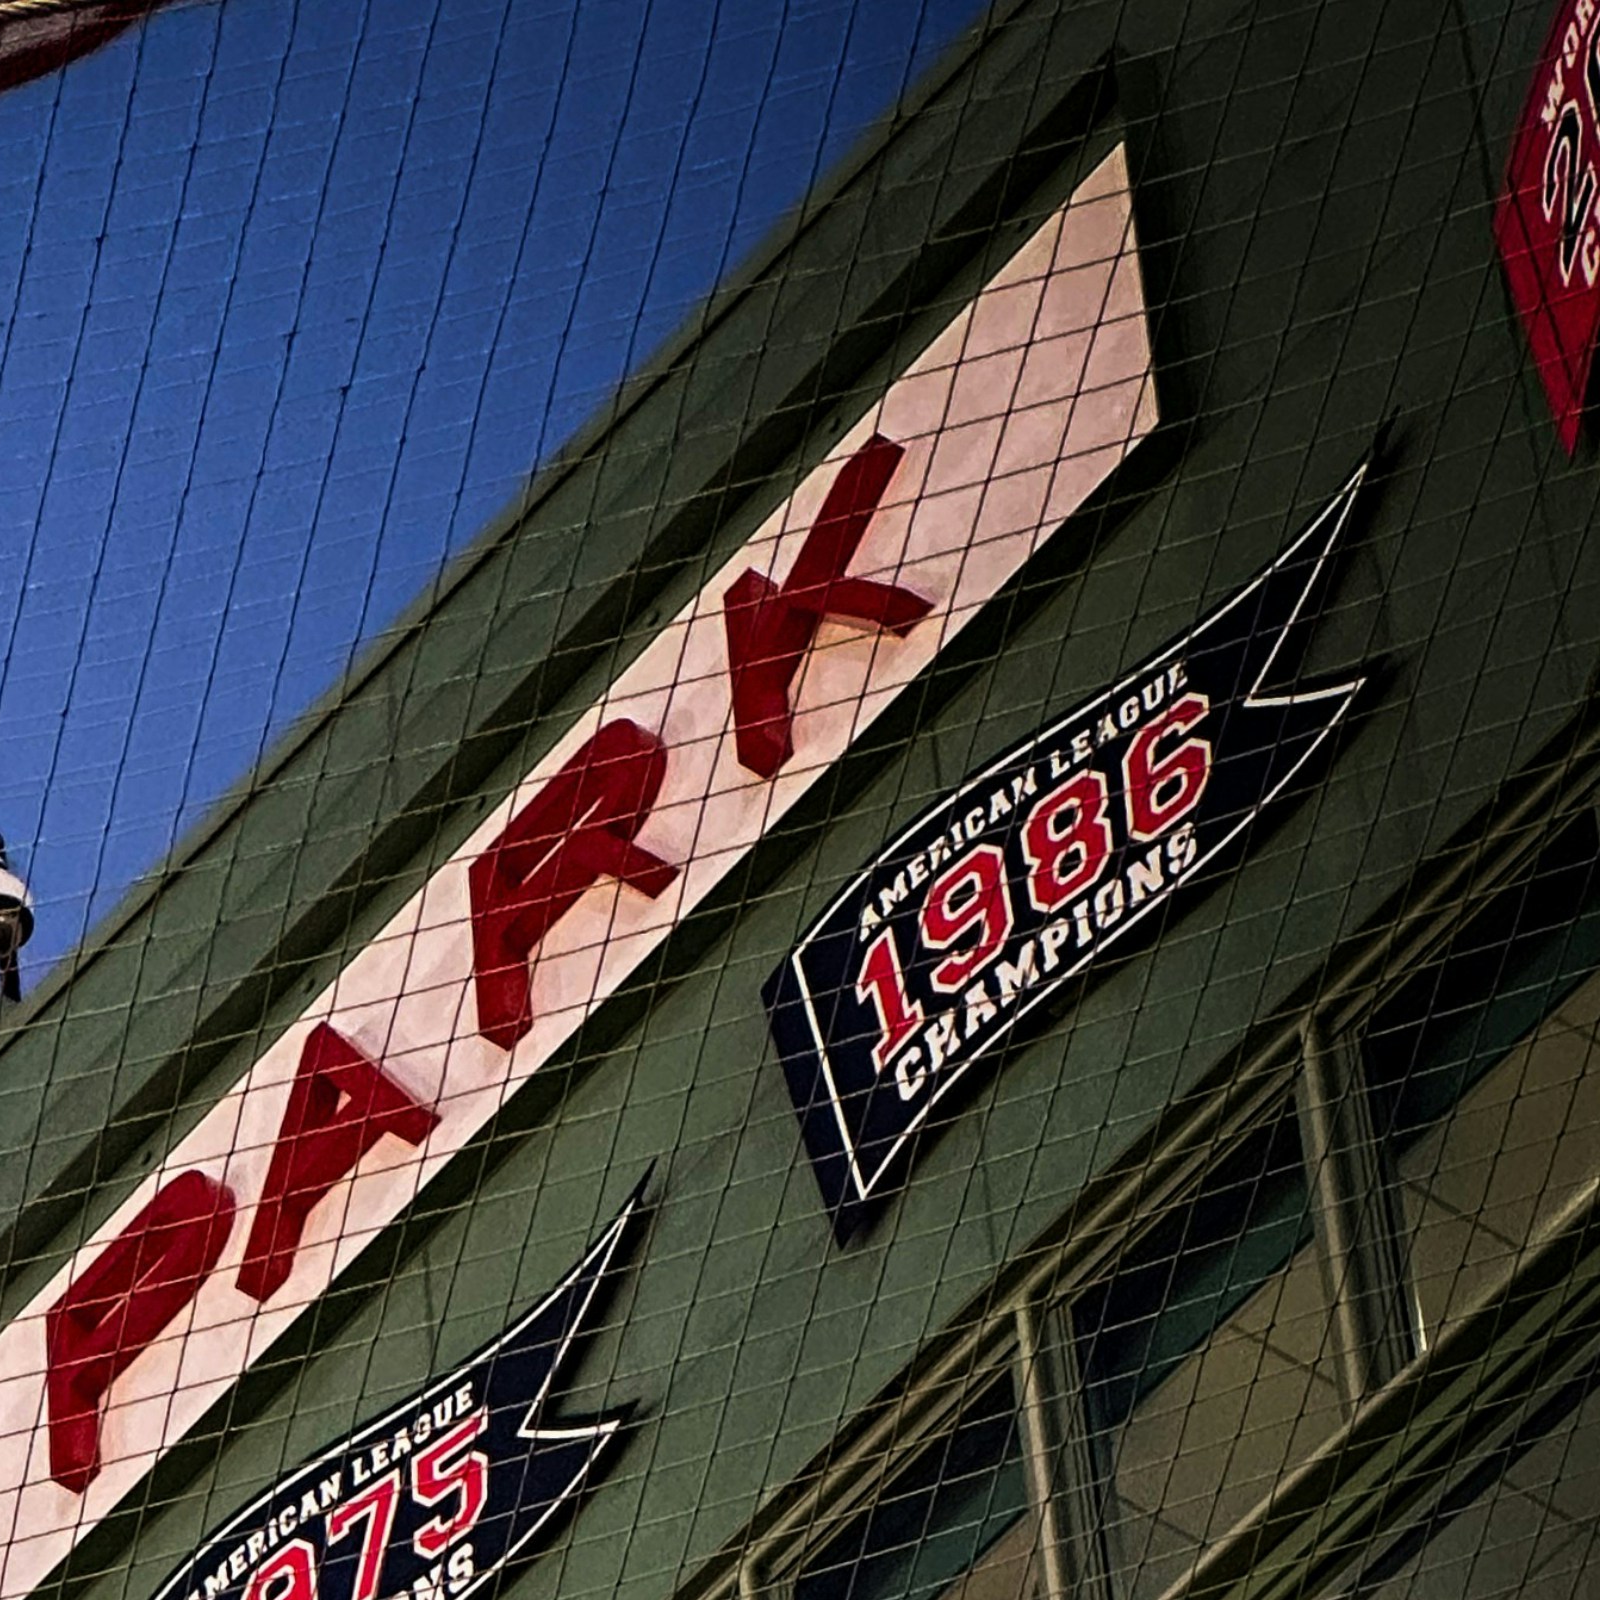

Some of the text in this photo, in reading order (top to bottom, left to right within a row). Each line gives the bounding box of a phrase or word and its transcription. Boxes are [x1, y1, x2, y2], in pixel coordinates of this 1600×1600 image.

[856, 691, 1212, 1074] 1986
[858, 661, 1188, 941] AMERICAN LEAGUE
[45, 434, 936, 1495] PARK
[893, 821, 1198, 1101] CHAMPIONS
[352, 1381, 474, 1493] LEAGUE
